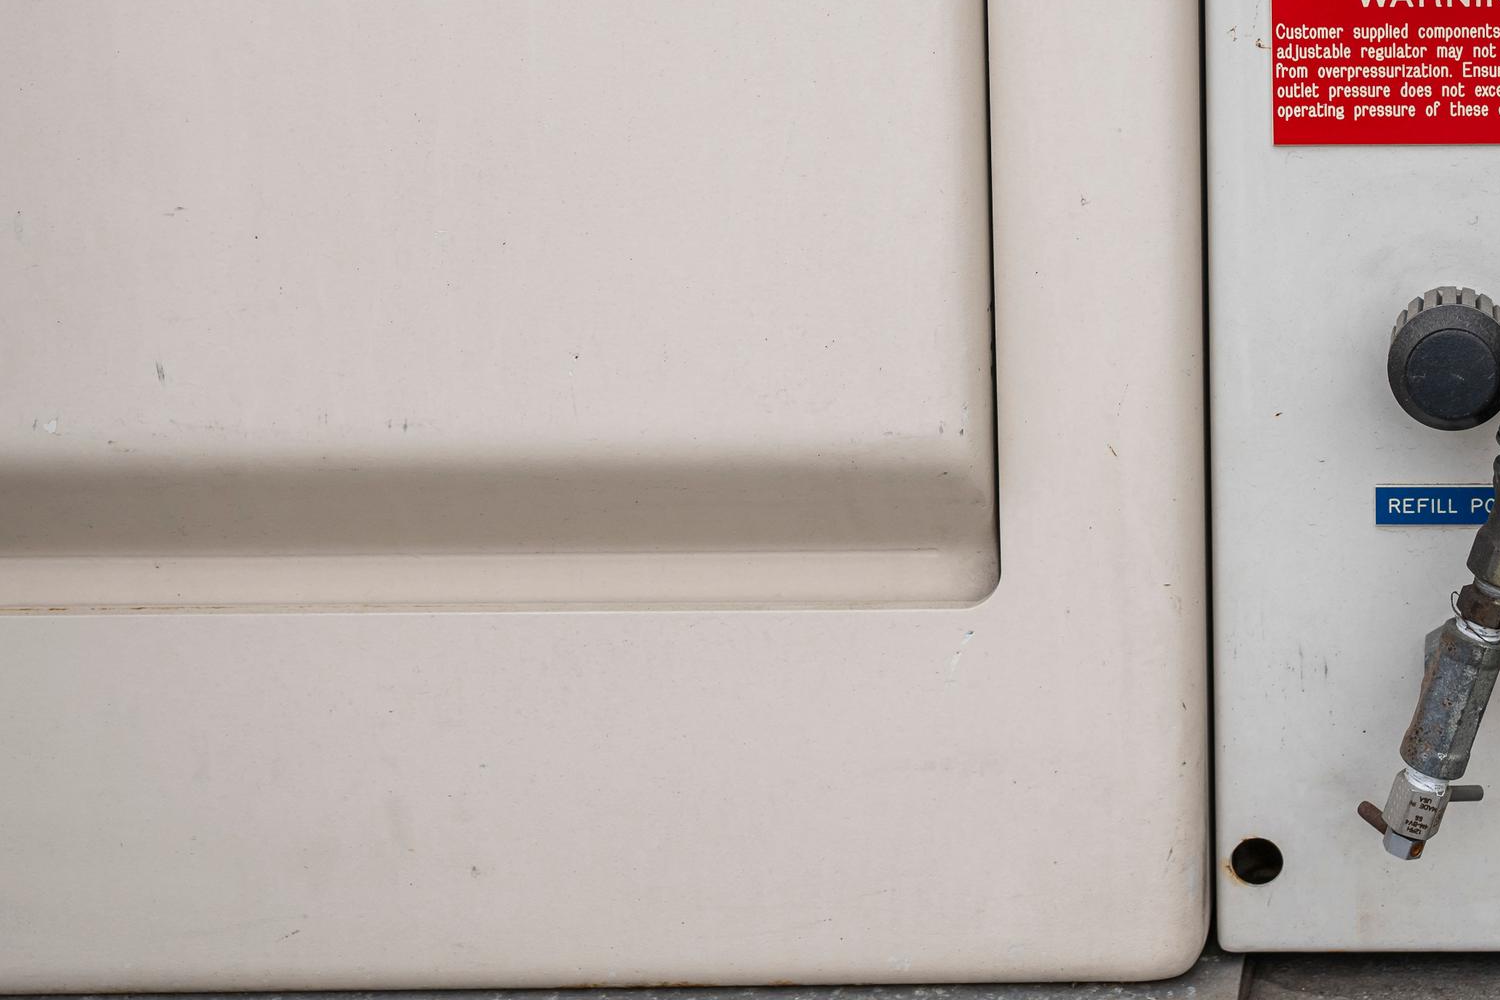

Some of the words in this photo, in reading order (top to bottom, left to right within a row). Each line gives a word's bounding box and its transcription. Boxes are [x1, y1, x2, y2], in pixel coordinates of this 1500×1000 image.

[1275, 24, 1344, 40] Customer
[1353, 23, 1408, 42] supplied
[1418, 25, 1500, 41] components
[1276, 44, 1351, 60] adjustable
[1360, 43, 1427, 60] regulator
[1436, 45, 1464, 61] may
[1472, 44, 1497, 58] not
[1275, 64, 1308, 79] from
[1317, 64, 1453, 81] overpressurization.
[1277, 83, 1319, 98] outlet
[1329, 85, 1391, 100] pressure
[1400, 82, 1432, 98] does
[1441, 83, 1465, 98] not
[1277, 103, 1345, 120] operating
[1353, 104, 1416, 120] pressure
[1425, 101, 1440, 116] of
[1450, 101, 1489, 117] these
[1388, 498, 1458, 514] REFILL
